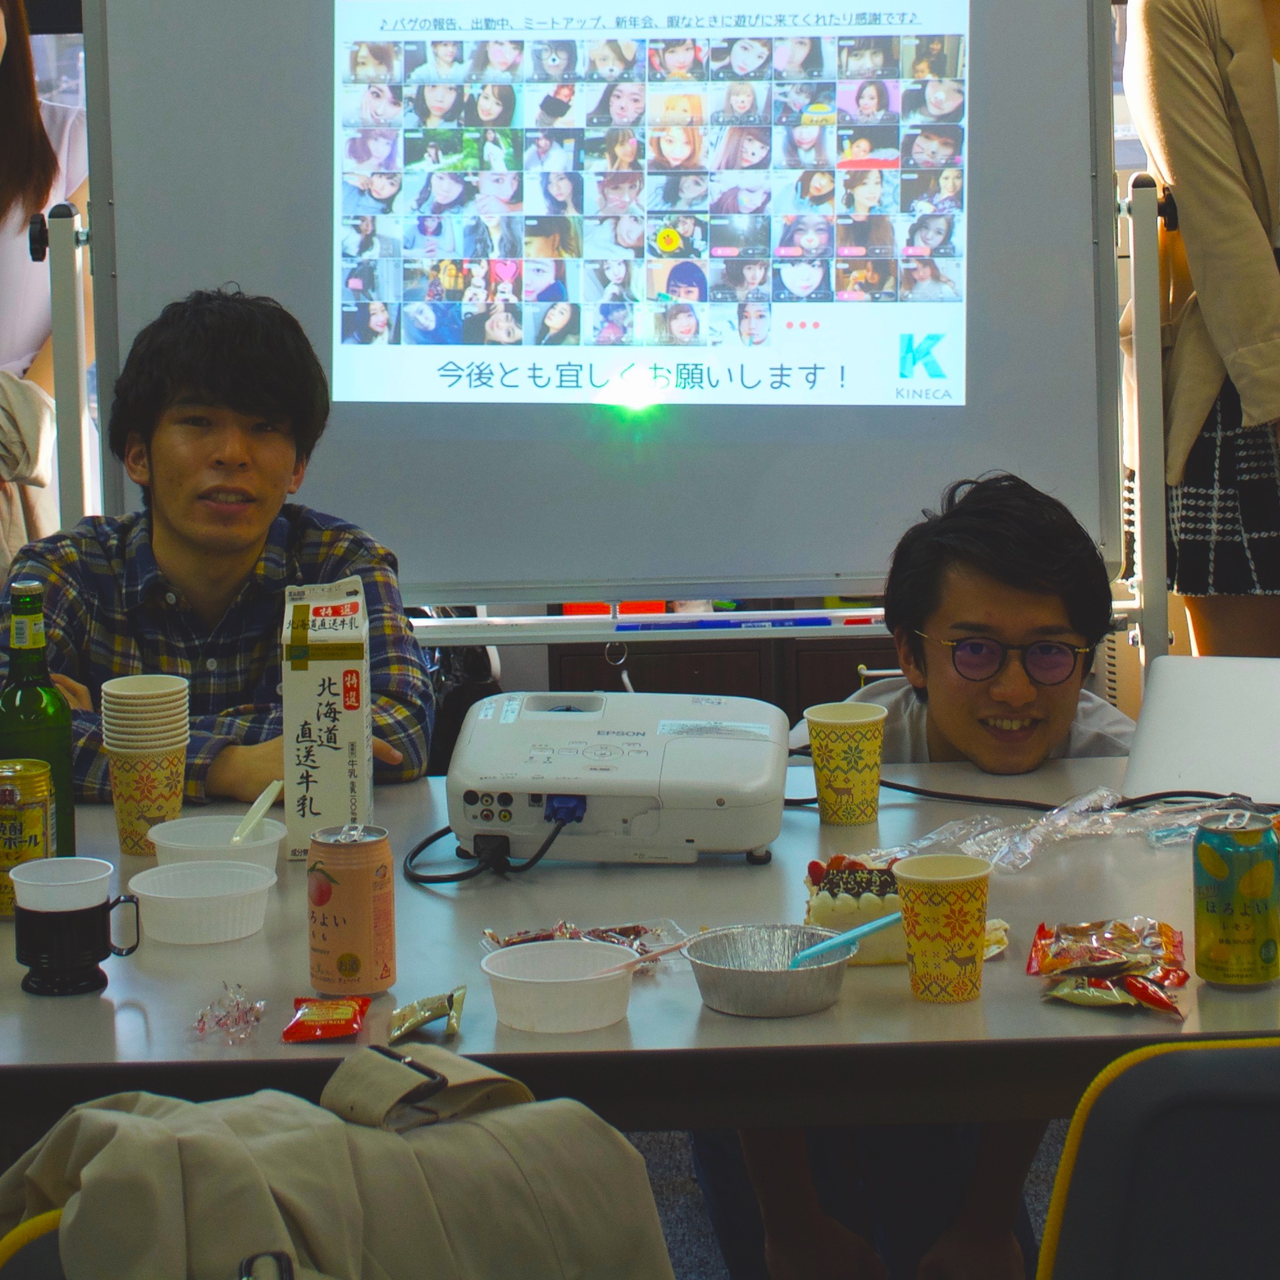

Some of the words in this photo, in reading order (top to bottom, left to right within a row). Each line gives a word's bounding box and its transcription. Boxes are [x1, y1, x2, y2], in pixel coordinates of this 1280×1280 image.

[895, 387, 953, 400] KINECA
[286, 617, 360, 632] 北海道直送牛乳
[344, 672, 359, 708] 特選
[316, 676, 344, 751] 北海道
[596, 729, 647, 737] EPSON
[295, 720, 322, 818] 直送牛乳
[347, 759, 359, 779] 牛乳
[1206, 899, 1269, 917] ほろよい
[310, 910, 347, 928] ろよい
